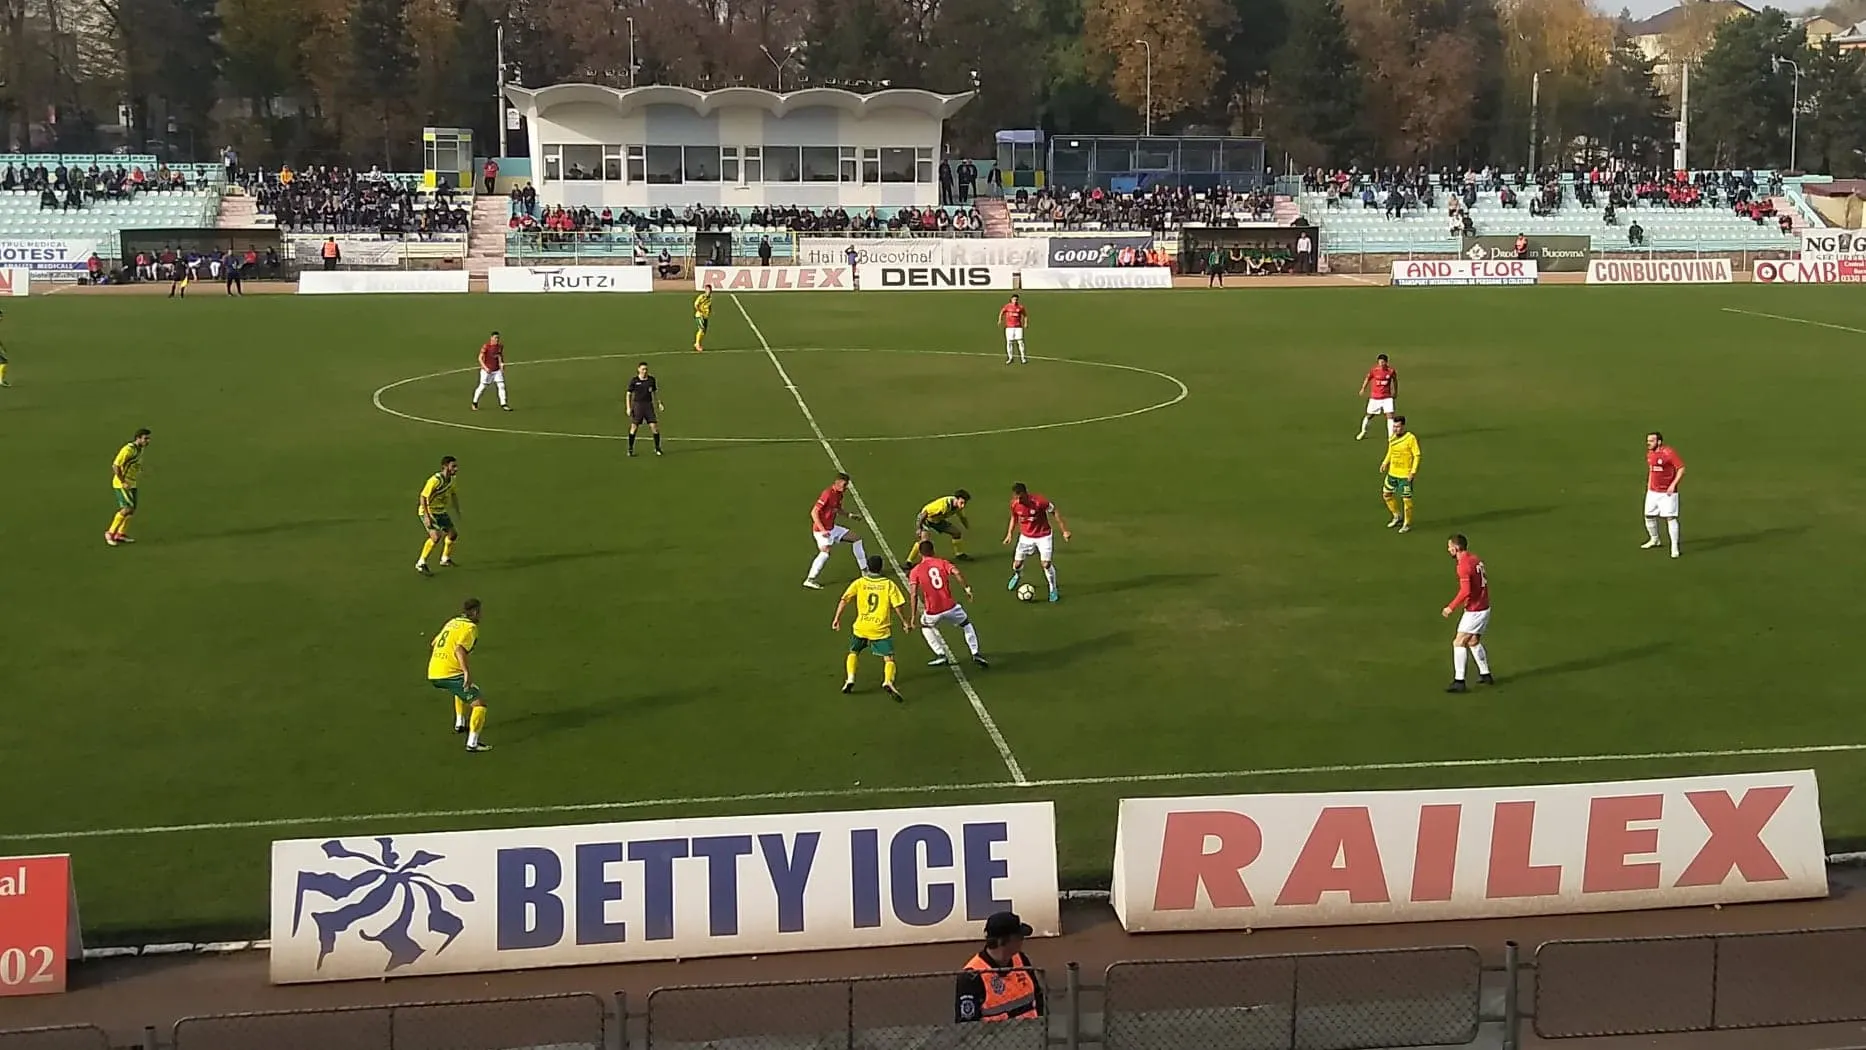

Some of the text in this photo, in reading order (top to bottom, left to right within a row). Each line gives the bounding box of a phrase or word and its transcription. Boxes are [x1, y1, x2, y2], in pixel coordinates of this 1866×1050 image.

[1806, 237, 1836, 252] NG
[808, 250, 834, 264] Hai
[857, 250, 933, 264] Bucovina!
[703, 268, 847, 289] RAILEX
[881, 267, 991, 286] DENIS
[1407, 262, 1451, 277] AND
[1471, 262, 1524, 277] FLOR
[1595, 261, 1727, 282] CONBUCOVINA
[928, 567, 943, 589] 8
[868, 593, 879, 613] 9
[1153, 785, 1794, 910] RAILEX
[497, 821, 1013, 951] BETTY ICE
